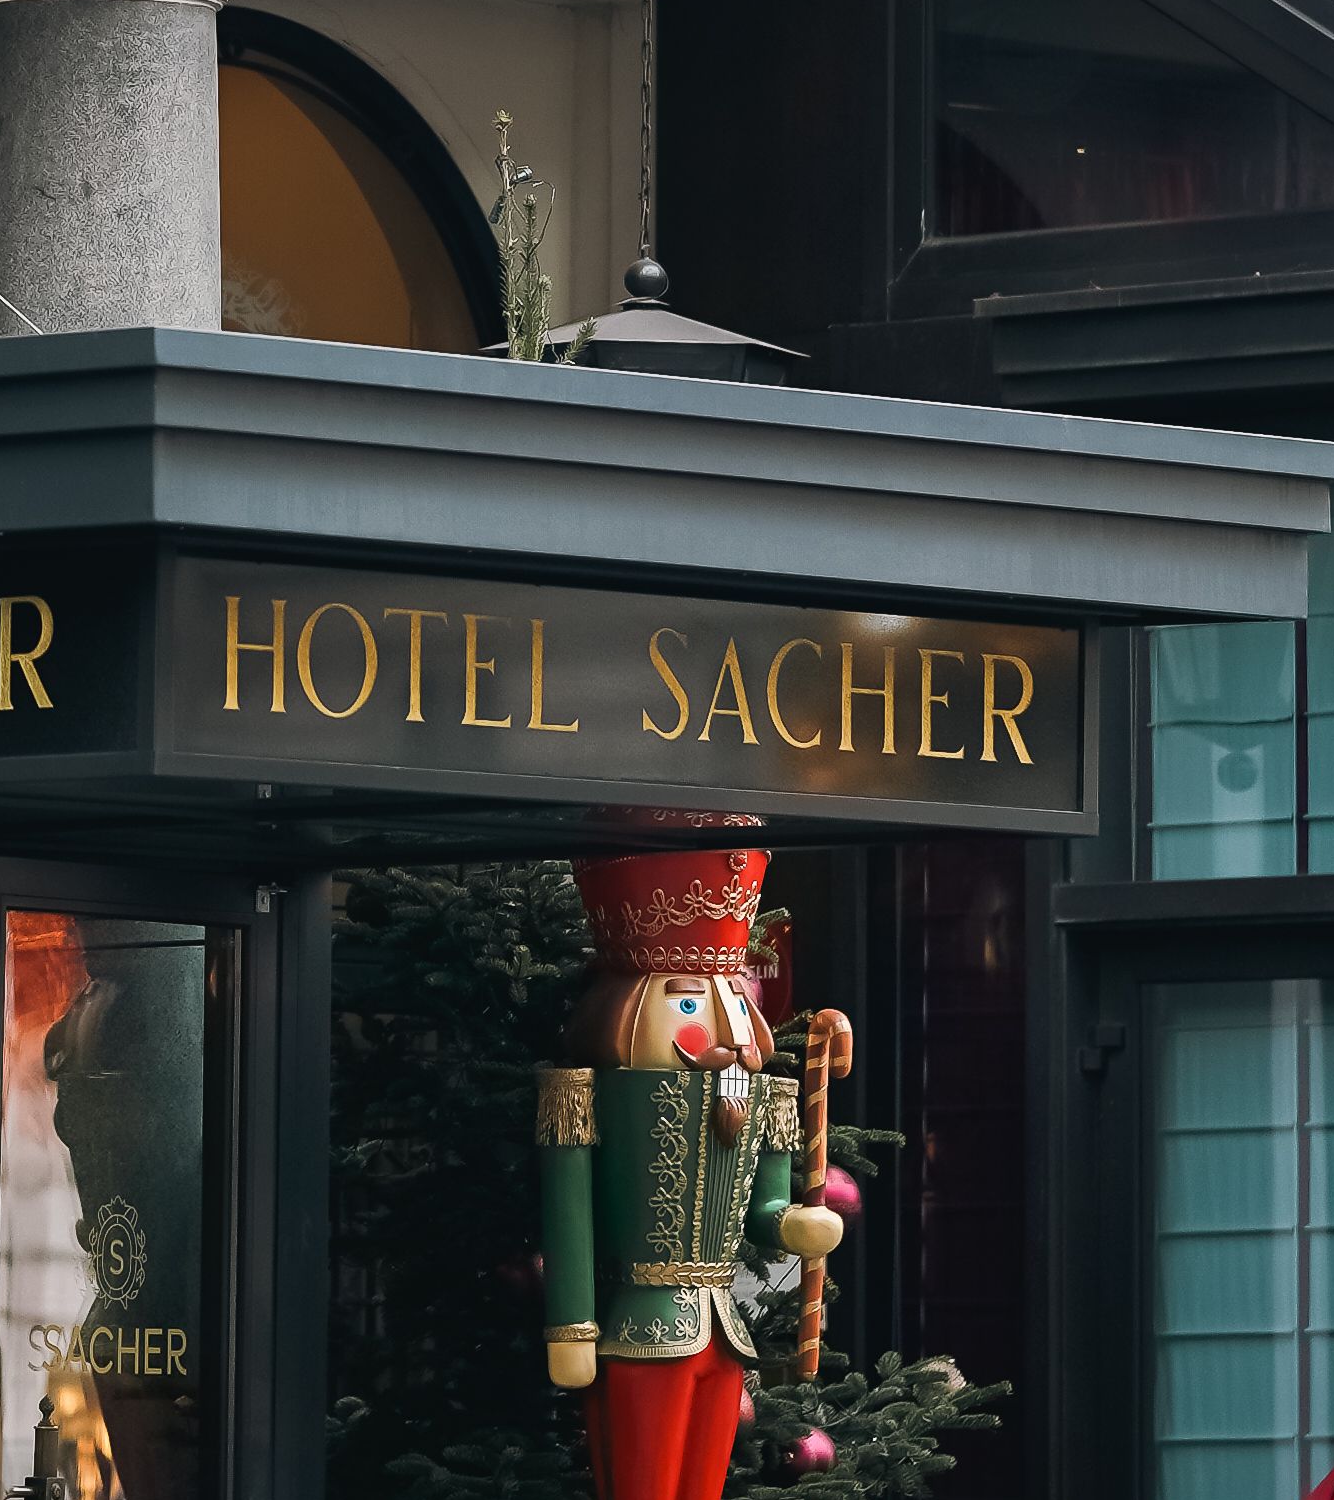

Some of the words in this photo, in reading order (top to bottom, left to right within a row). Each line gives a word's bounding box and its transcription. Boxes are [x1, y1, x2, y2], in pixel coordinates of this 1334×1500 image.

[223, 596, 579, 733] HOTEL
[642, 627, 1034, 765] SACHER
[43, 1324, 187, 1376] SACHER
